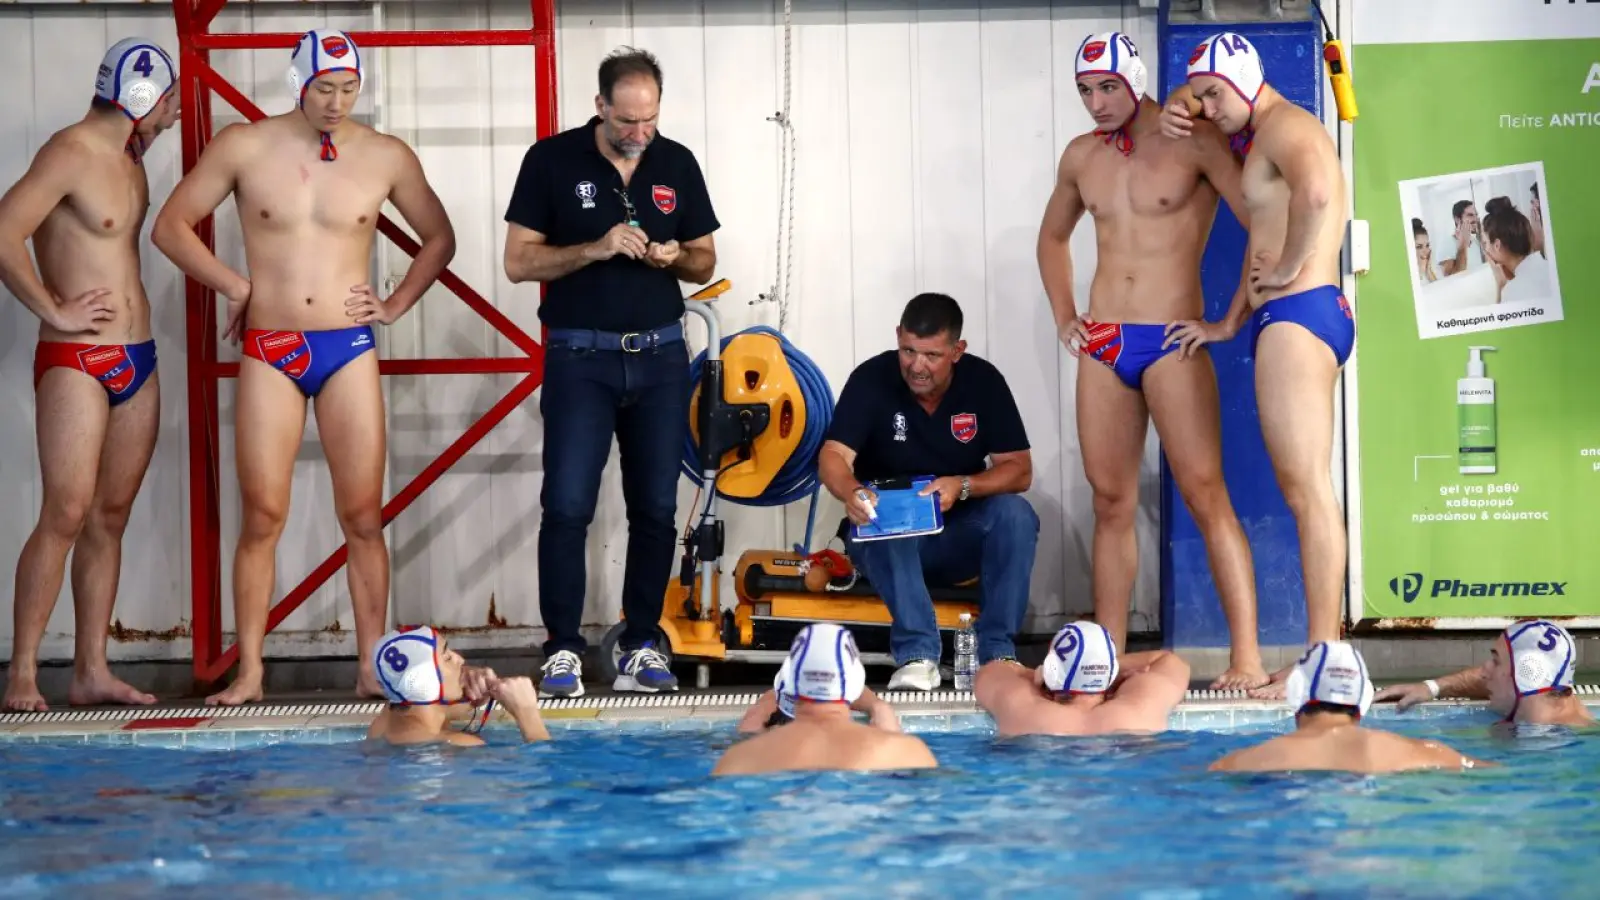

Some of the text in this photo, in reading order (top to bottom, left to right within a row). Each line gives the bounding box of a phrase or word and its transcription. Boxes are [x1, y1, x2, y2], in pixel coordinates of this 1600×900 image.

[1220, 34, 1249, 57] 14
[132, 50, 154, 77] 4
[1499, 113, 1544, 128] Πείτε
[1436, 307, 1544, 329] Καθημερινή φροντίδα
[1440, 482, 1519, 496] gel για βαθύ
[1446, 496, 1514, 509] καθαρισμό
[1412, 509, 1549, 523] προσώπου & σώματος
[1431, 579, 1568, 598] Pharmex
[1537, 627, 1560, 652] 5
[383, 646, 409, 673] 8
